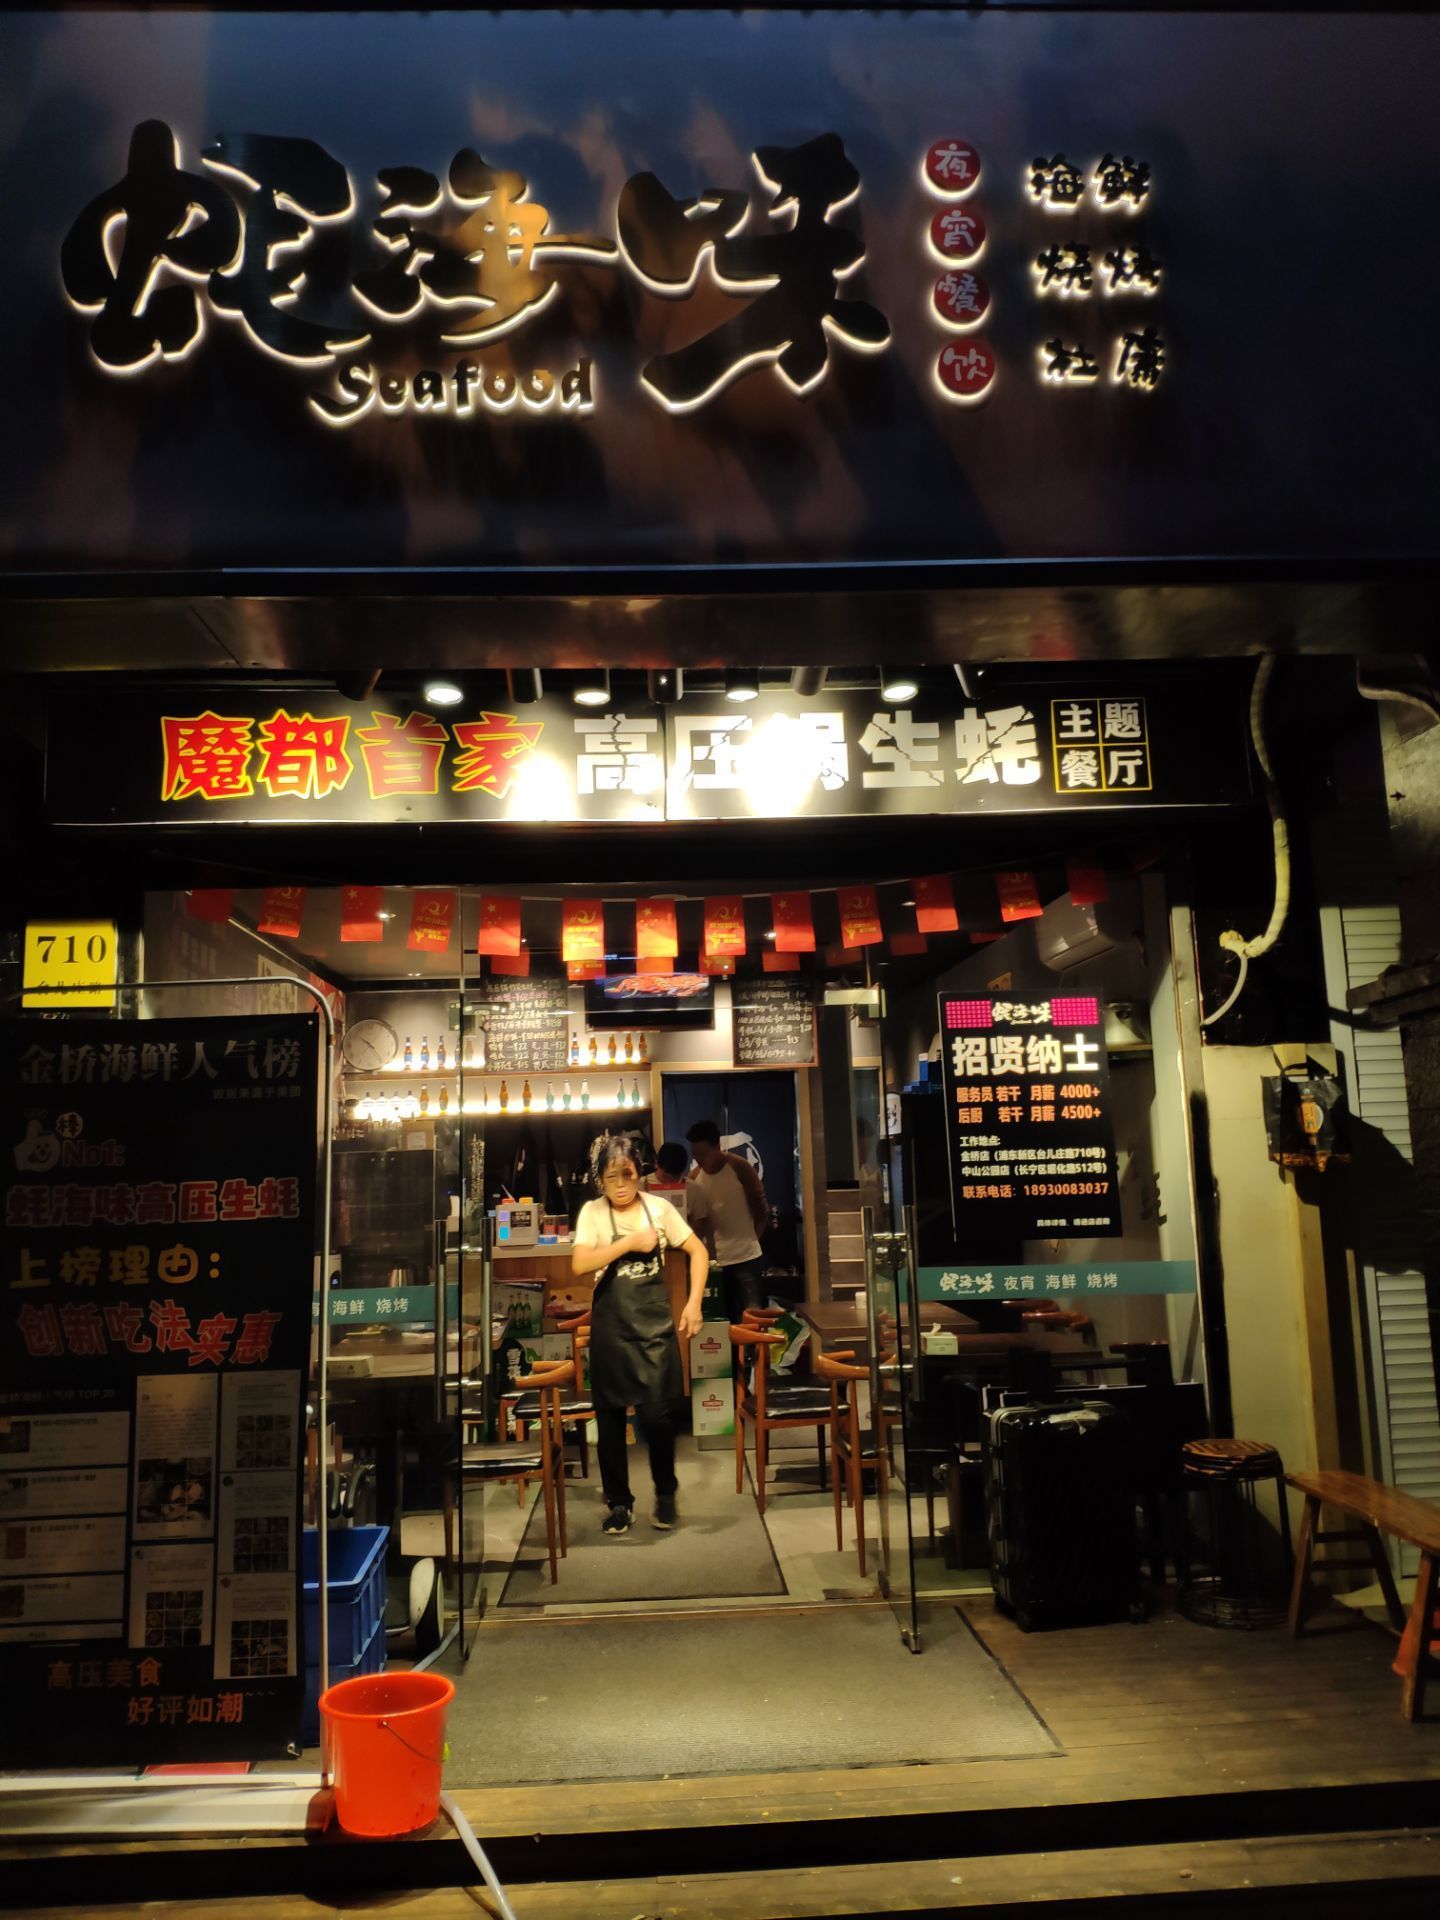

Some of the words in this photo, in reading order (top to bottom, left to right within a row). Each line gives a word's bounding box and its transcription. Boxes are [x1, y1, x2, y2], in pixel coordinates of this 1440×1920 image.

[309, 358, 597, 428] Seafood
[1059, 702, 1144, 744] 主题
[160, 708, 544, 802] 魔都首家
[1060, 748, 1144, 789] 餐厅
[36, 934, 108, 964] 710
[18, 1038, 302, 1085] 金桥海鲜人气榜
[951, 1032, 1100, 1077] 招贤纳士
[956, 1086, 993, 1103] 服务员
[996, 1086, 1021, 1102] 若干
[1030, 1085, 1055, 1101] 月薪
[1060, 1084, 1101, 1099] 4000+
[958, 1107, 983, 1124] 后厨
[998, 1106, 1024, 1123] 若干
[1030, 1106, 1055, 1122] 月薪
[1061, 1104, 1102, 1120] 4500+
[1023, 1181, 1110, 1197] 18930083037
[1003, 1275, 1035, 1291] 夜宵
[1045, 1274, 1077, 1291] 海鲜
[1086, 1272, 1119, 1289] 烧烤
[332, 1299, 365, 1316] 海鲜
[375, 1297, 409, 1314] 烧烤
[16, 1299, 284, 1368] 创新吃法实惠
[47, 1656, 164, 1690] 高压美食
[127, 1691, 246, 1728] 好评如潮
